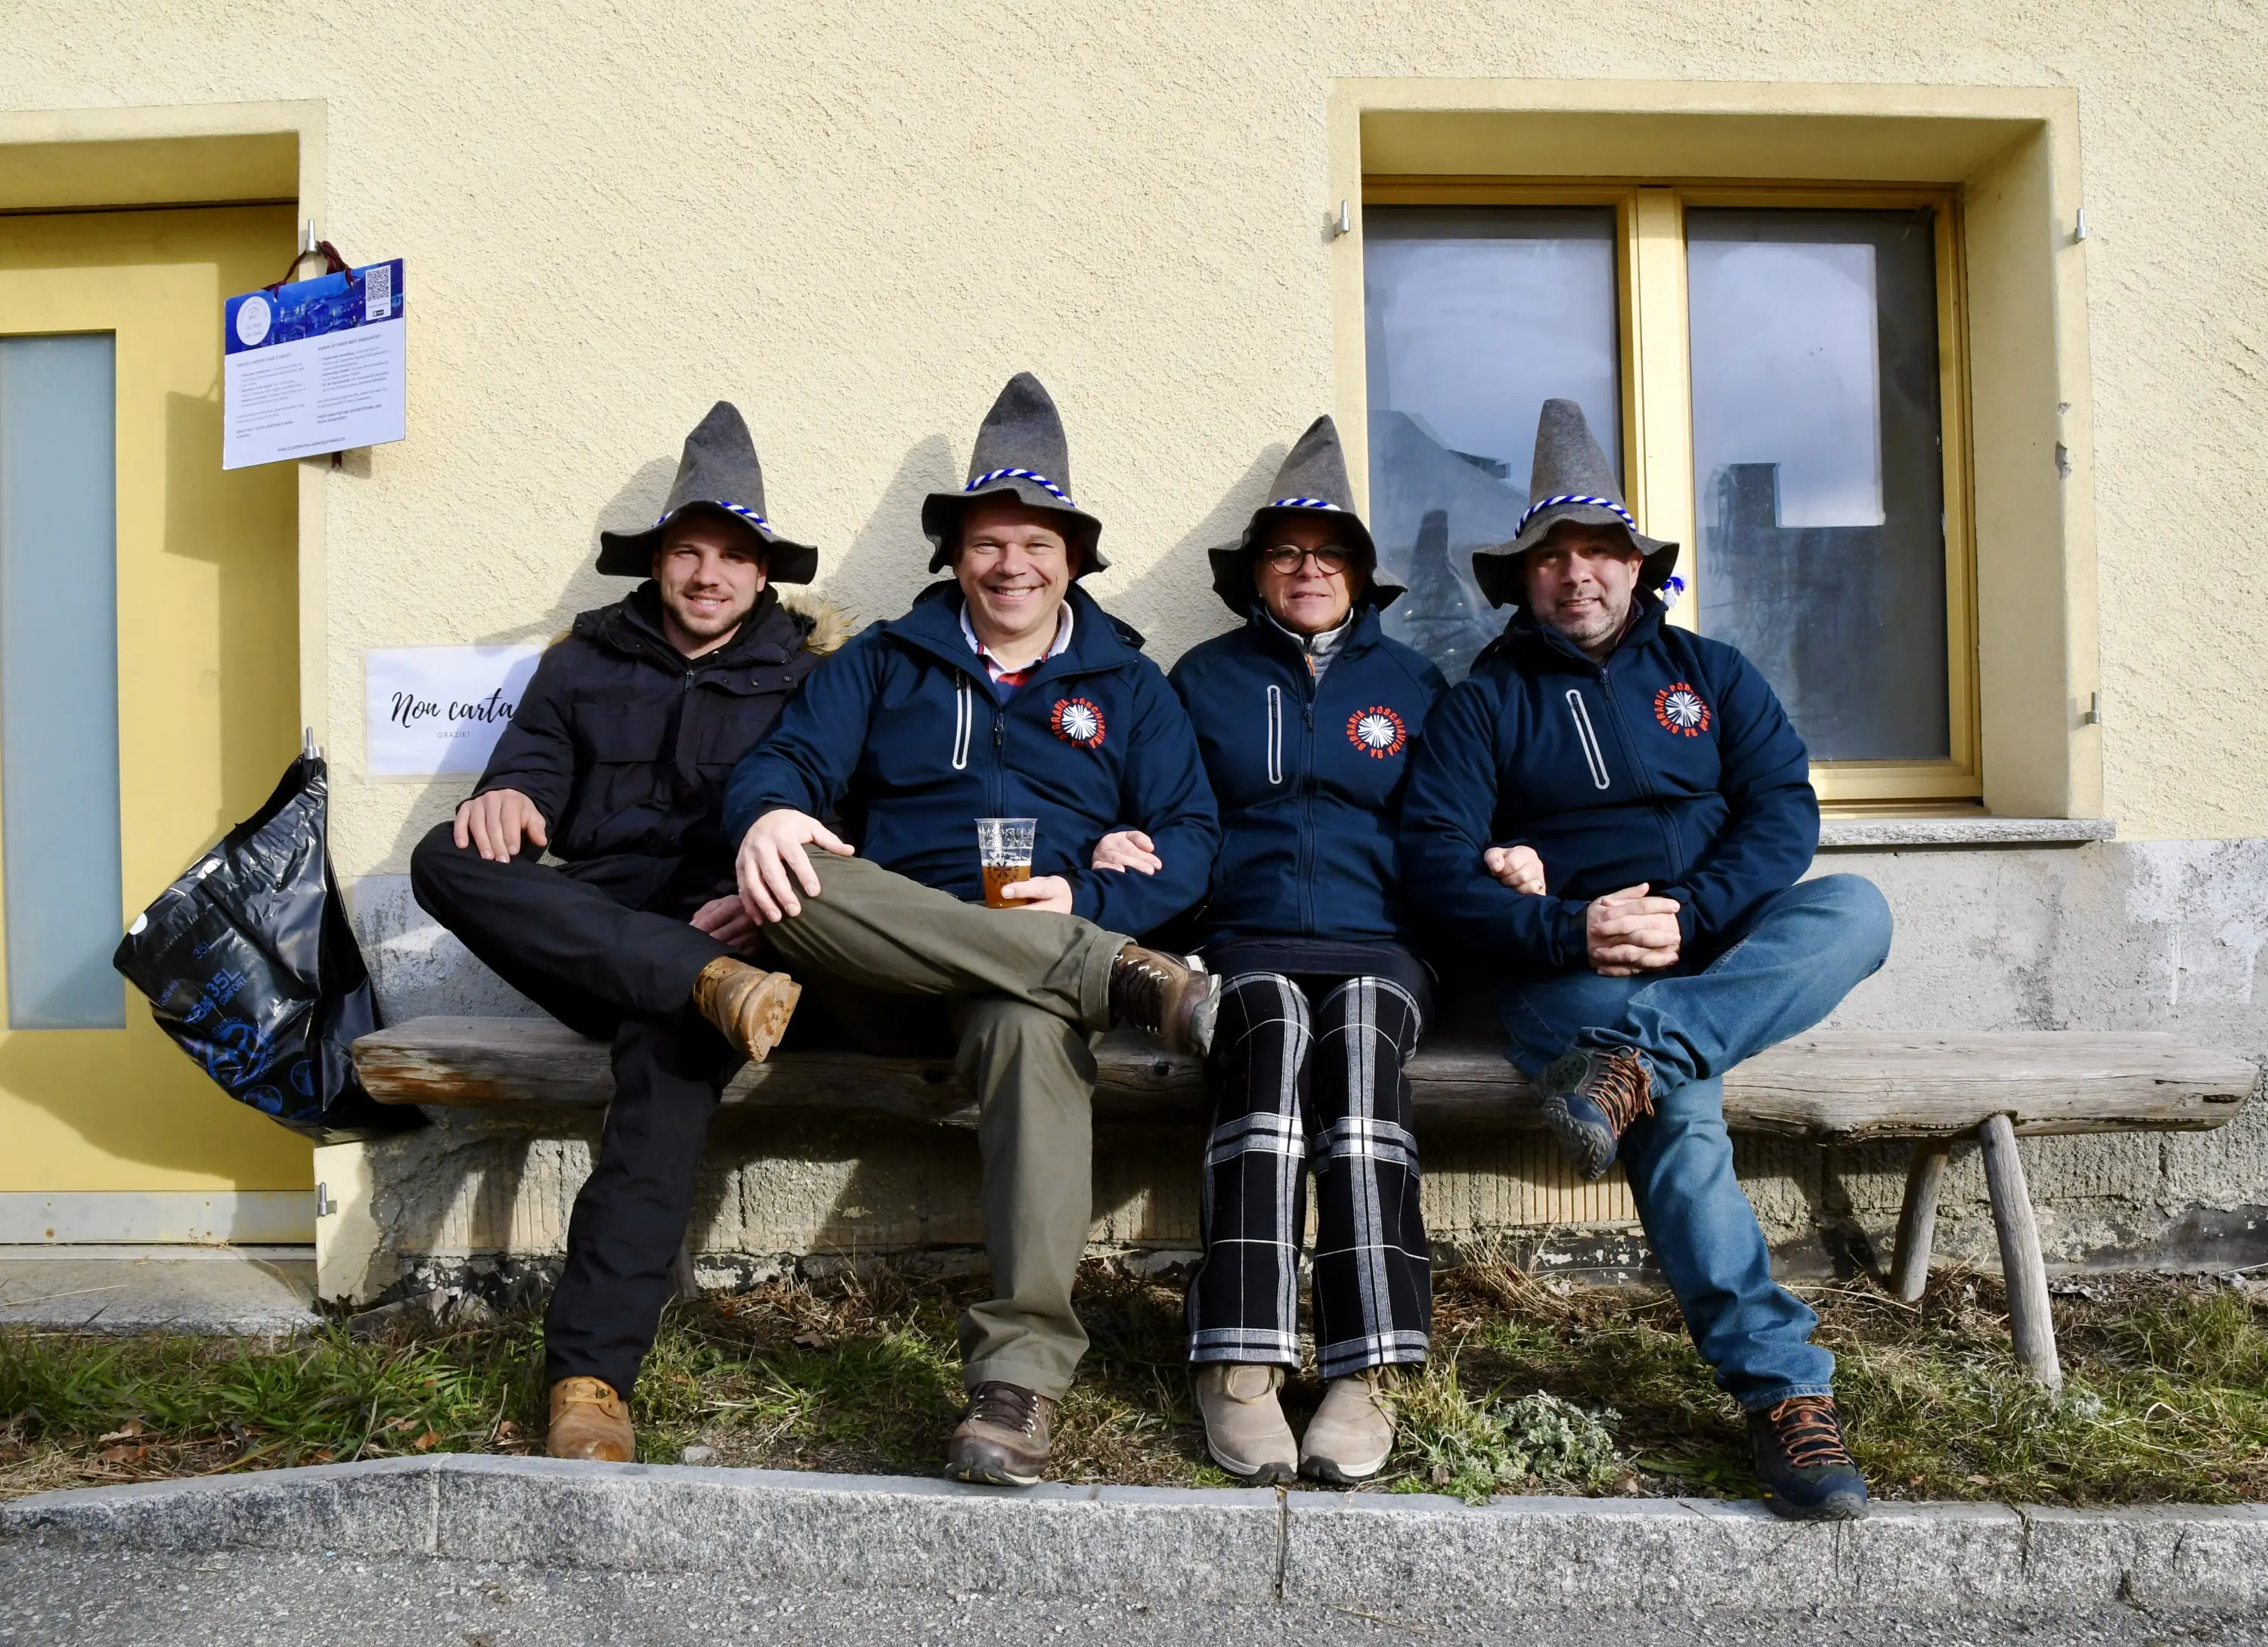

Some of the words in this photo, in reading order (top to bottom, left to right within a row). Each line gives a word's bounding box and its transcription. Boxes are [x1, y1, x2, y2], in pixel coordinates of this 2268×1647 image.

[391, 691, 441, 728] Non
[448, 687, 517, 724] carta
[1346, 710, 1366, 751] BIRRARIA
[1369, 706, 1406, 756] POSCHIAVINA
[1371, 748, 1384, 759] SA
[206, 968, 241, 997] 35L
[218, 975, 247, 1006] COMFORT
